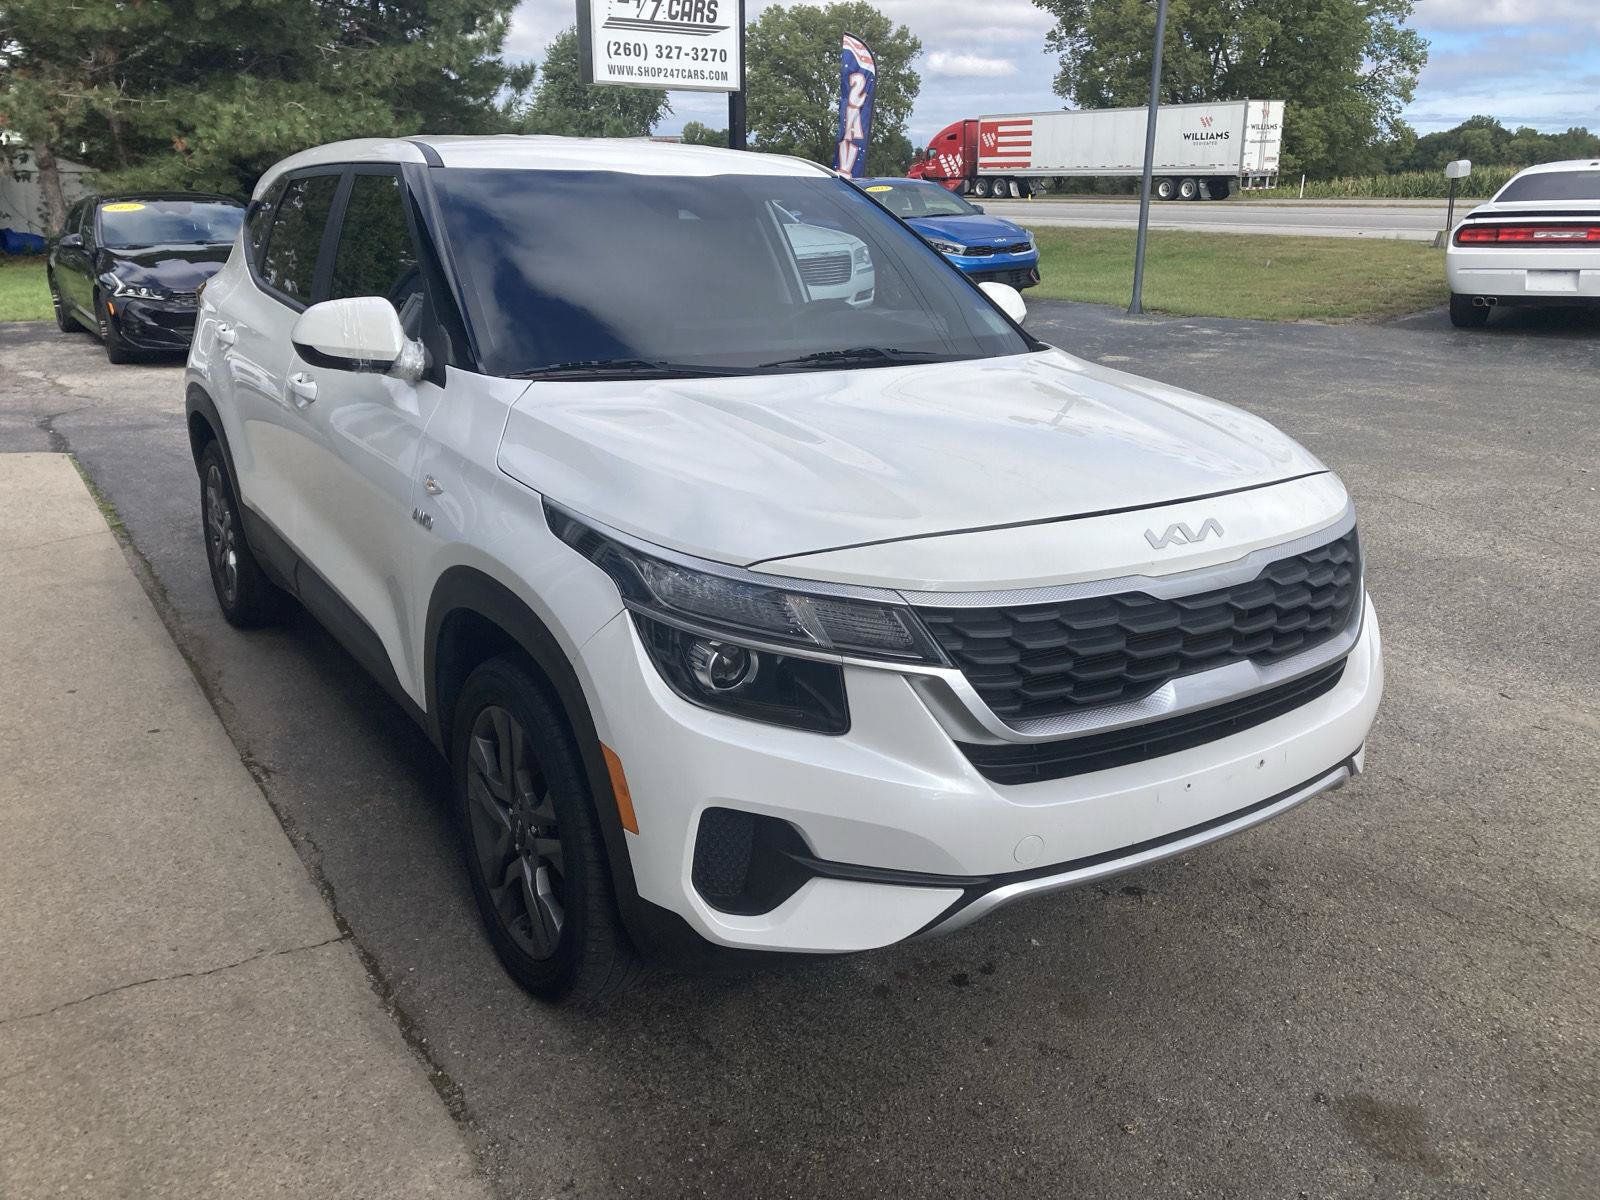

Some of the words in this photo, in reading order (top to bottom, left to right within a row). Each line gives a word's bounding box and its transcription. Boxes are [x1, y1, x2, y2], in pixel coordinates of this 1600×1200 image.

[667, 0, 719, 24] CARS
[607, 40, 648, 61] (260)
[655, 44, 728, 63] 327-3270
[607, 64, 728, 81] WWW.SHOP247CARS.COM
[1183, 131, 1230, 140] WILLIAMS
